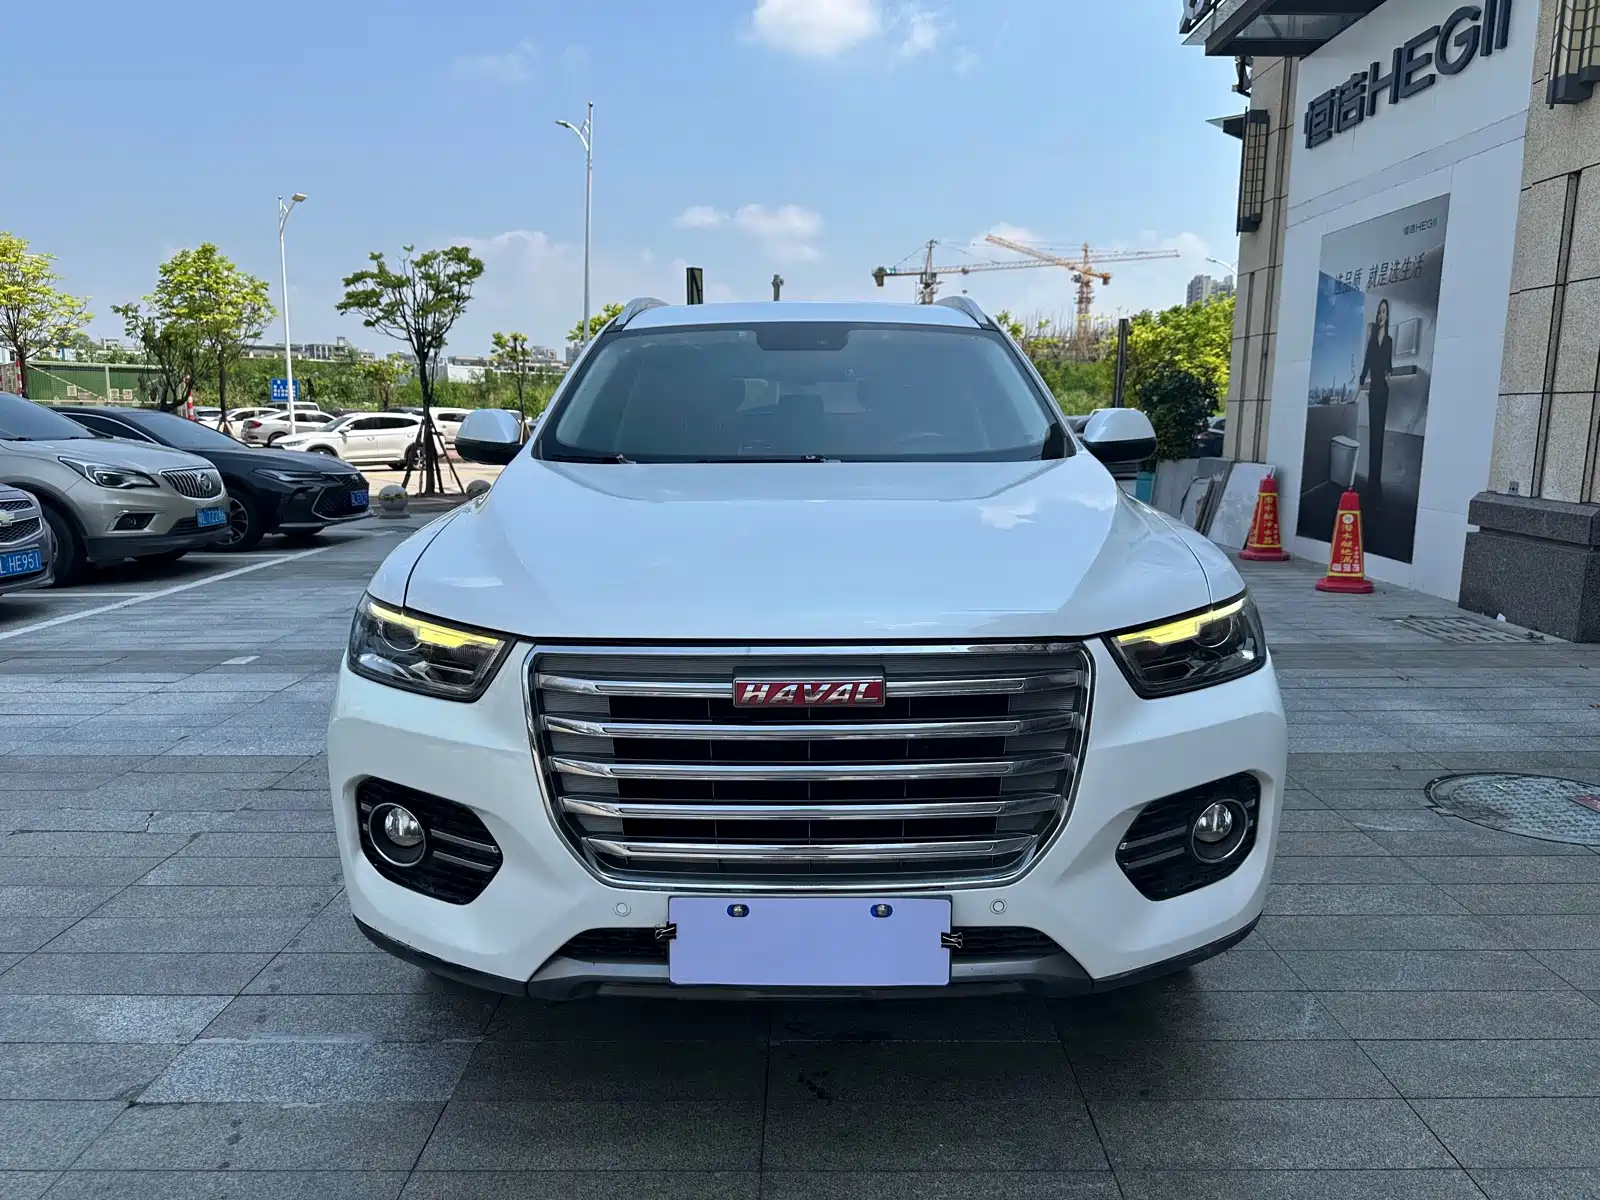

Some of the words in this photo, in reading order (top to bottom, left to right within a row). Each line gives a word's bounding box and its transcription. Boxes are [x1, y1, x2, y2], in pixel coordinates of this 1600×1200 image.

[1333, 267, 1364, 295] 选品质
[1366, 251, 1426, 289] 就是选生活
[740, 684, 878, 704] HAVAL
